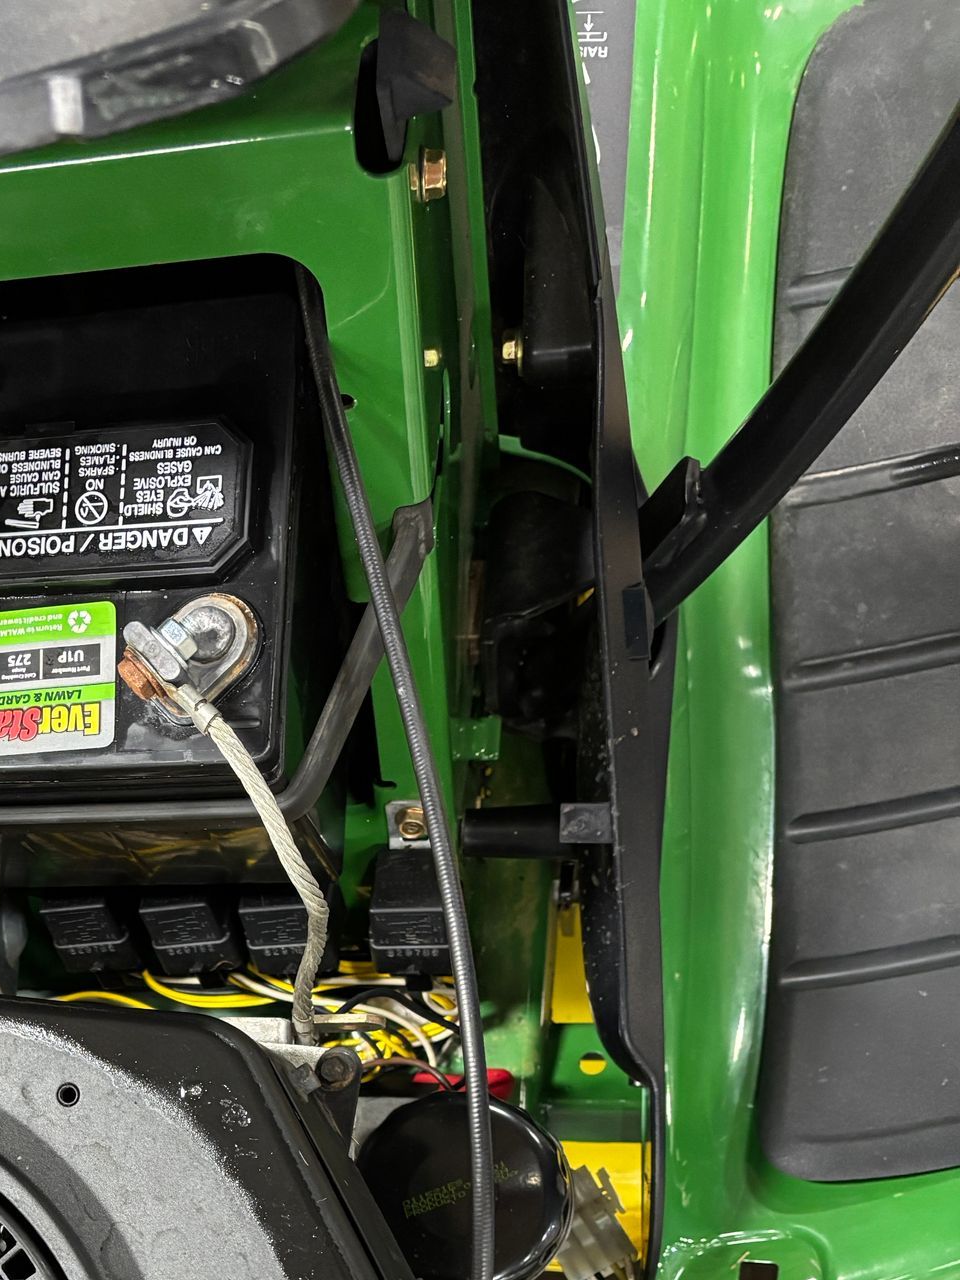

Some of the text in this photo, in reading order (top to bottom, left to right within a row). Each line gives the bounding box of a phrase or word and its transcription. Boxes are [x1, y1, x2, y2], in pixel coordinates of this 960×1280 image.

[152, 436, 197, 448] OR INJURY
[29, 448, 61, 459] SEVERE
[75, 443, 116, 455] SMOKING
[129, 445, 221, 461] CAN CAUSE BLINDNESS
[12, 459, 60, 472] BLINDNESS
[80, 455, 115, 465] FLAMES
[79, 465, 115, 476] SPARKS
[157, 461, 192, 474] GASES
[10, 470, 60, 483] CAN CAUSE
[133, 474, 191, 490] EXPLOSIVE
[10, 481, 60, 496] SULFURIC
[86, 479, 104, 490] NO
[136, 489, 164, 502] EYES
[124, 503, 163, 516] SHIELD
[80, 534, 94, 552] /
[99, 527, 188, 550] DANGER
[23, 616, 46, 624] credit
[36, 624, 62, 632] Return
[8, 653, 31, 666] 275
[58, 650, 84, 663] U1P
[34, 693, 42, 703] &
[45, 689, 81, 701] LAWN
